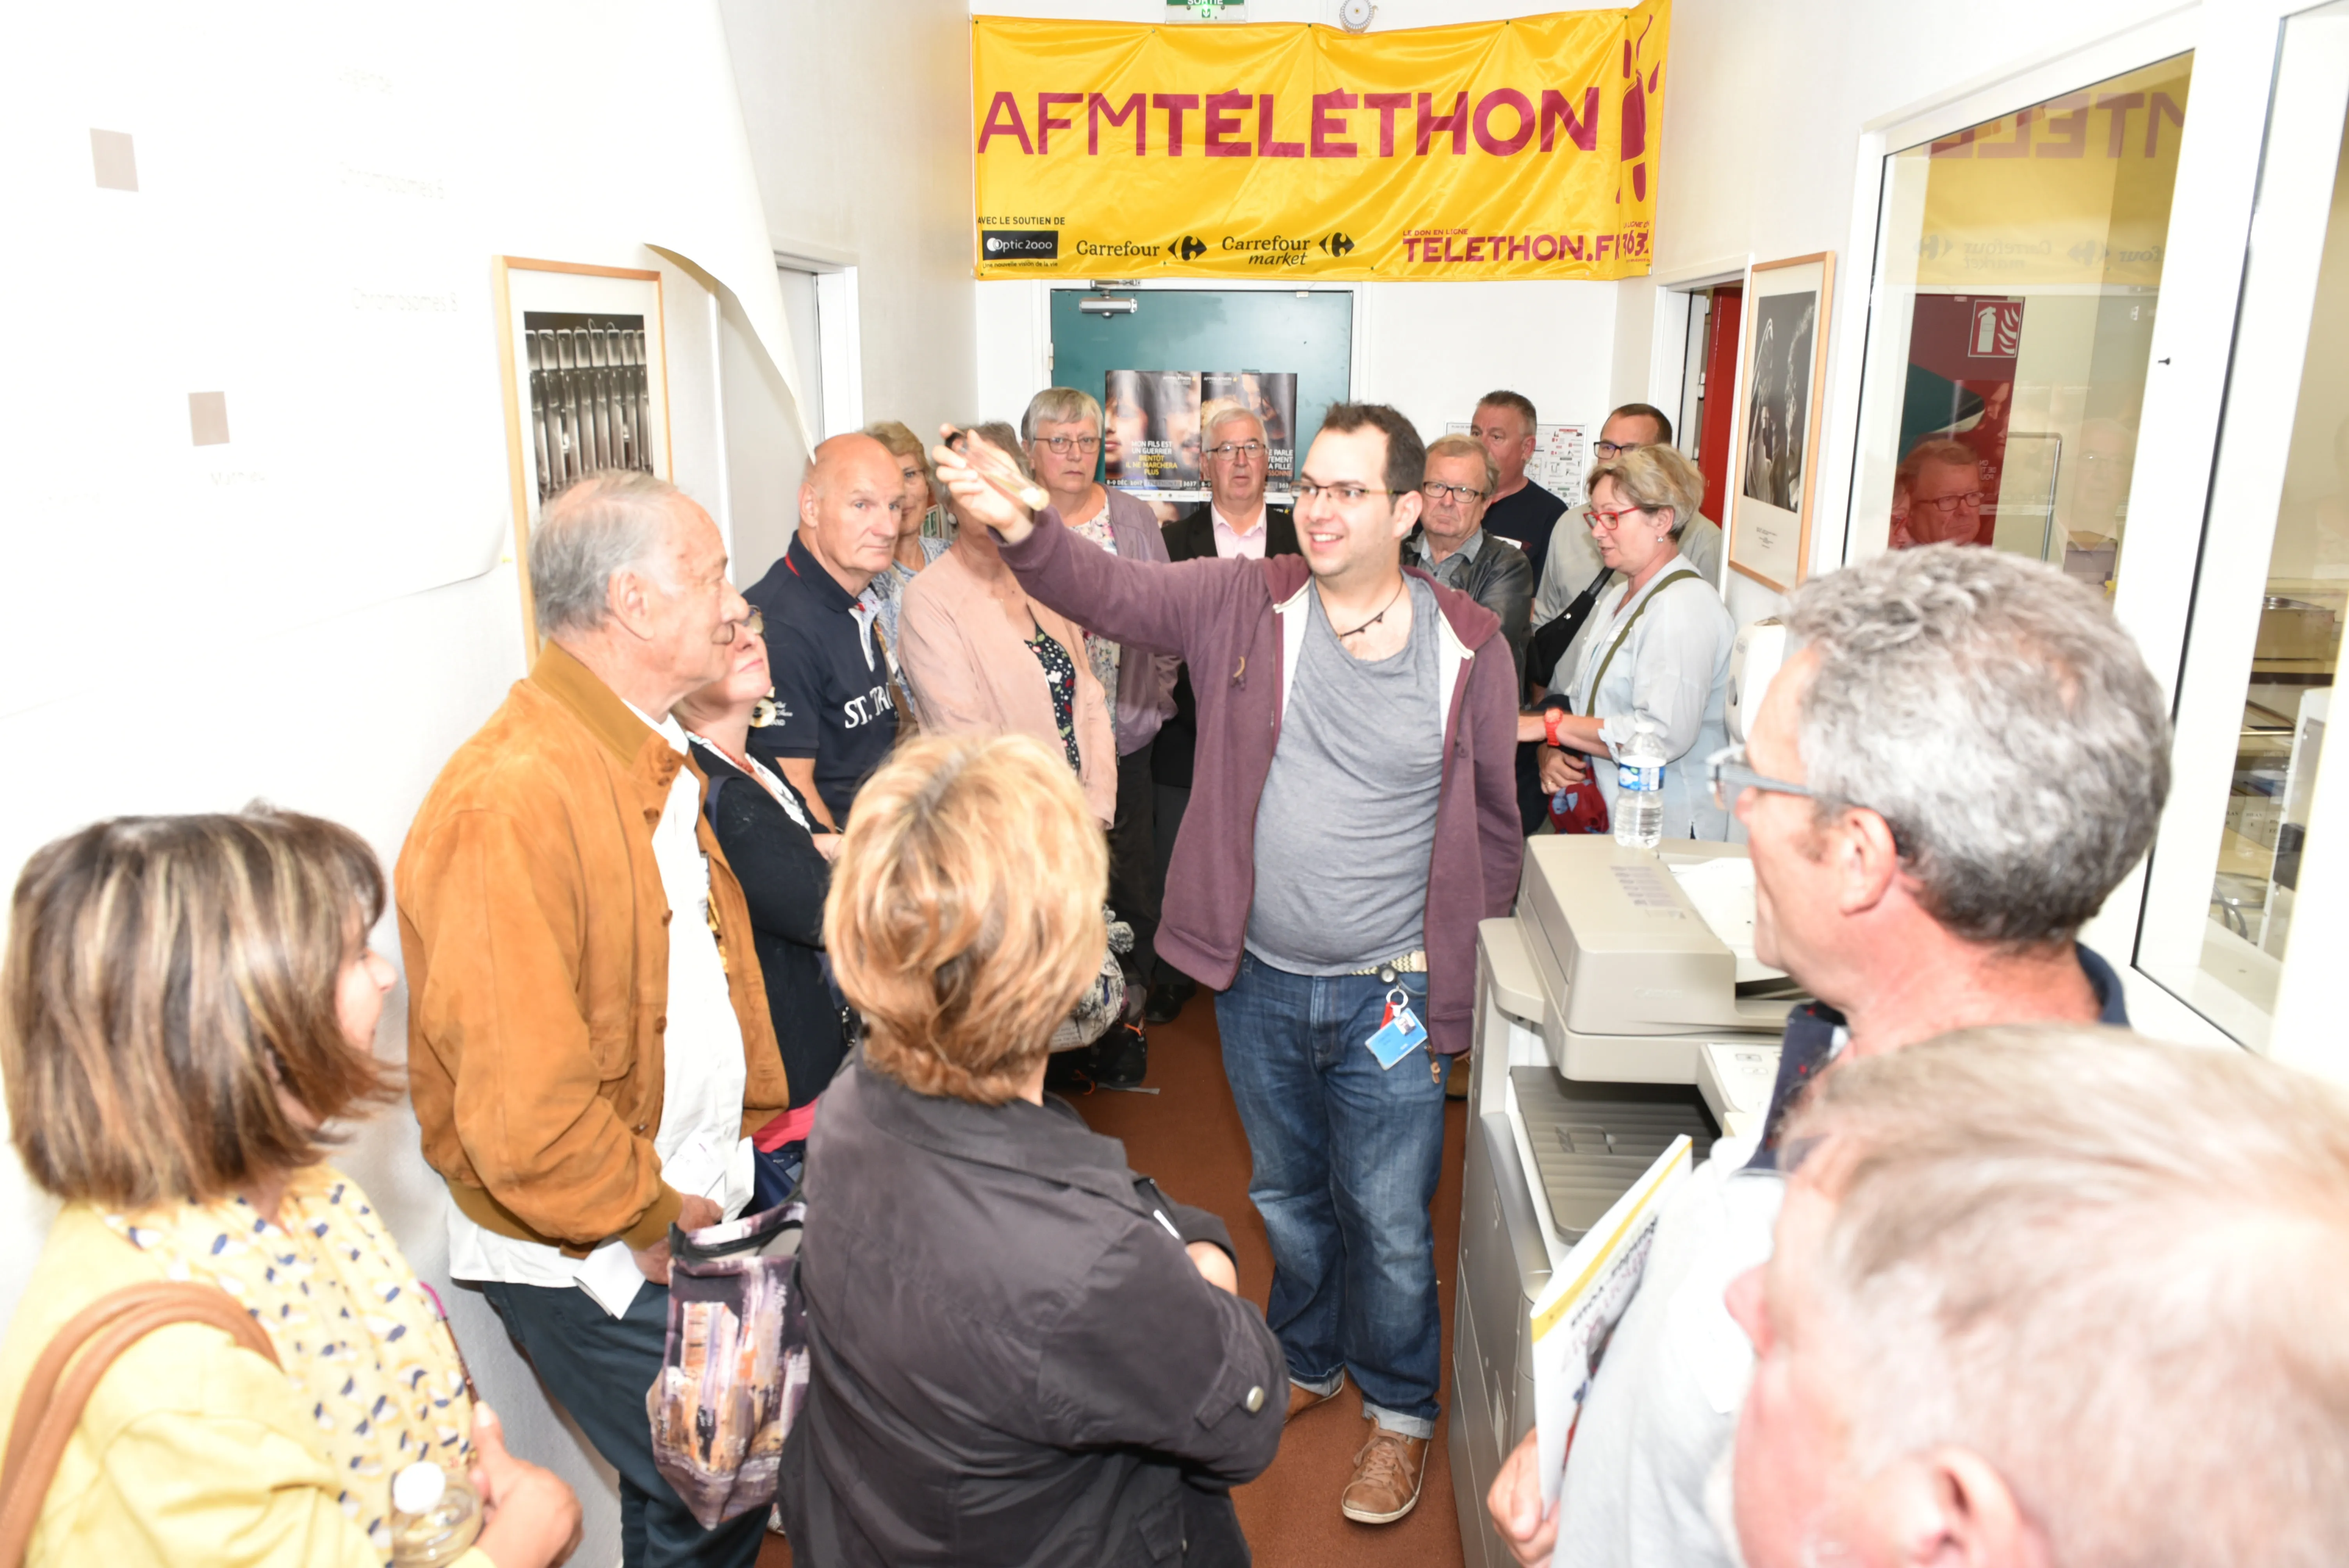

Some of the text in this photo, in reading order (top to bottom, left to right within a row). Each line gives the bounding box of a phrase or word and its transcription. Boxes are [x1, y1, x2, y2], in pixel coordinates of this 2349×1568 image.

[977, 216, 1065, 225] AVEC LE SOUTIEN DE
[993, 239, 1053, 253] Optic 2000
[1076, 240, 1160, 257] Carrefour
[1222, 235, 1310, 251] Carrefour
[1248, 251, 1308, 266] market
